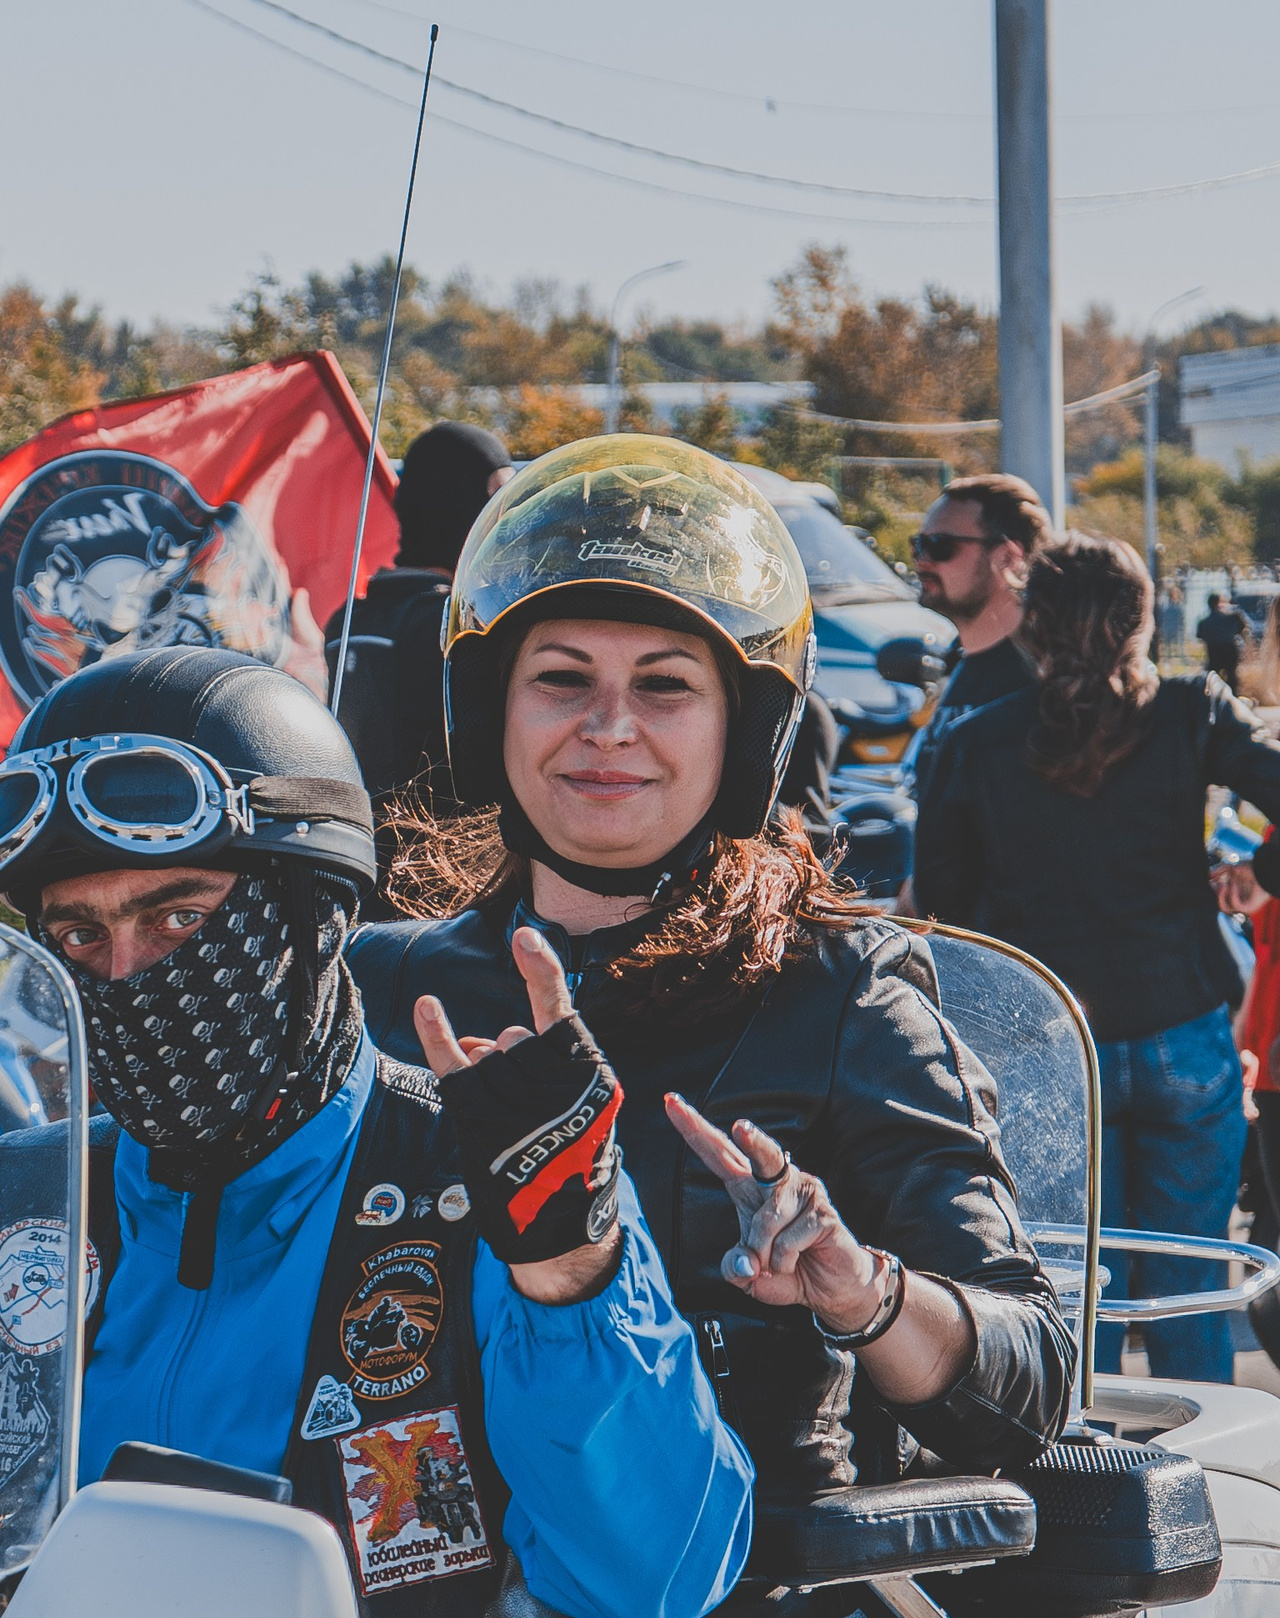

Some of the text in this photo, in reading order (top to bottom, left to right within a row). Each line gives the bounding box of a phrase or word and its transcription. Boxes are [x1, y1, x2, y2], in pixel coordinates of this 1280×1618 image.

[507, 1105, 595, 1184] CONCEPT
[28, 1231, 62, 1245] 2014
[368, 1247, 436, 1270] Khabarovsk
[358, 1261, 434, 1299] БЕСПЕЧНЫЙ ЕЗДОК
[360, 1352, 418, 1370] МОТОФОРУМ
[354, 1366, 425, 1396] TERRANO
[0, 1418, 46, 1433] ПАМЯТИ
